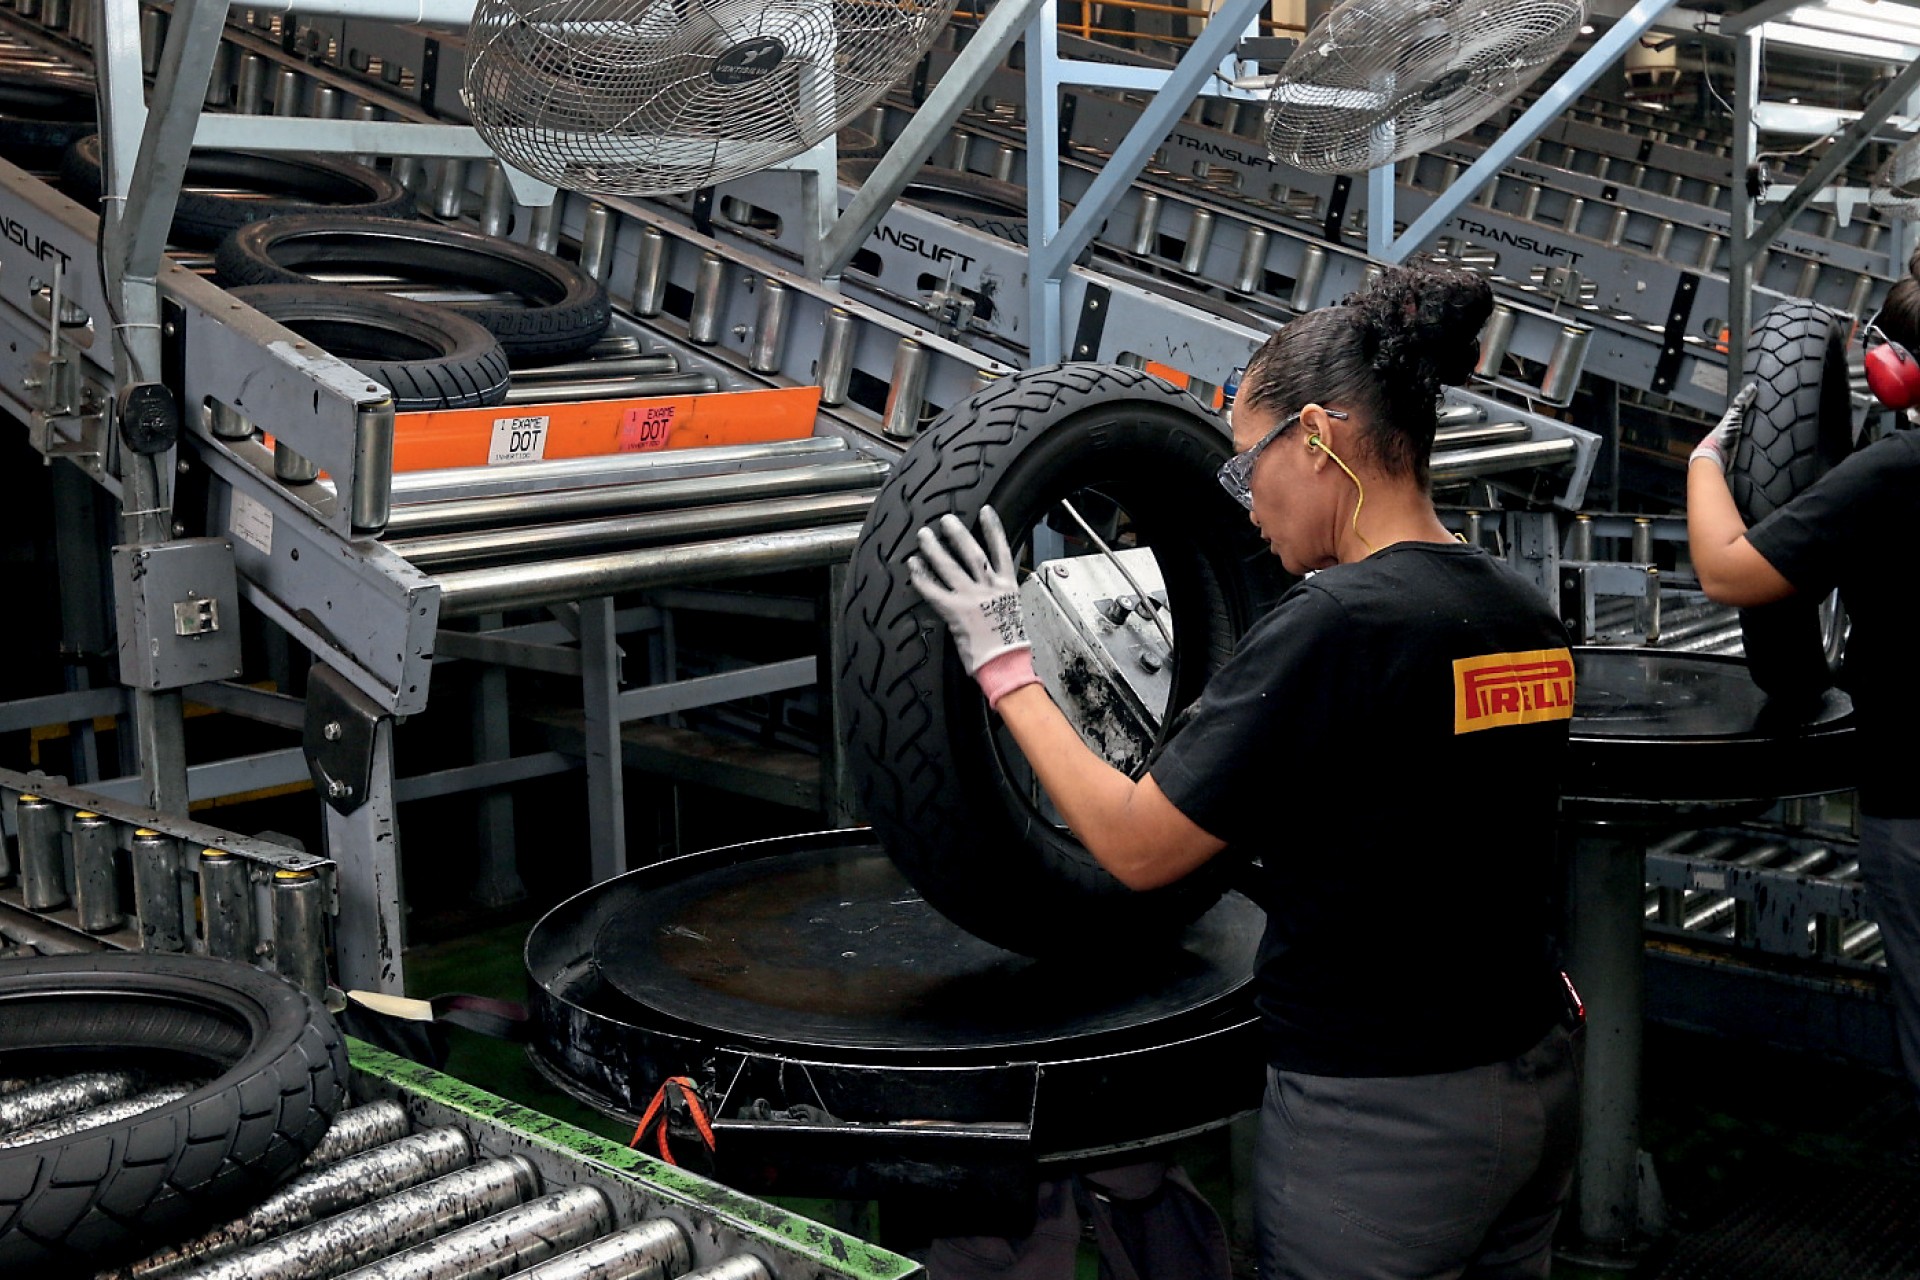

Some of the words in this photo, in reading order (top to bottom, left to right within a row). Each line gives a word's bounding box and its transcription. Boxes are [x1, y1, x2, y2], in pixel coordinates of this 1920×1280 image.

[1175, 134, 1278, 173] TRANSLIFT
[1457, 217, 1583, 264] TRANSLIFT
[511, 417, 542, 431] EXAME
[647, 406, 676, 419] EXAME
[509, 430, 541, 452] DOT
[640, 418, 670, 441] DOT
[1463, 660, 1573, 720] PIRELLI
